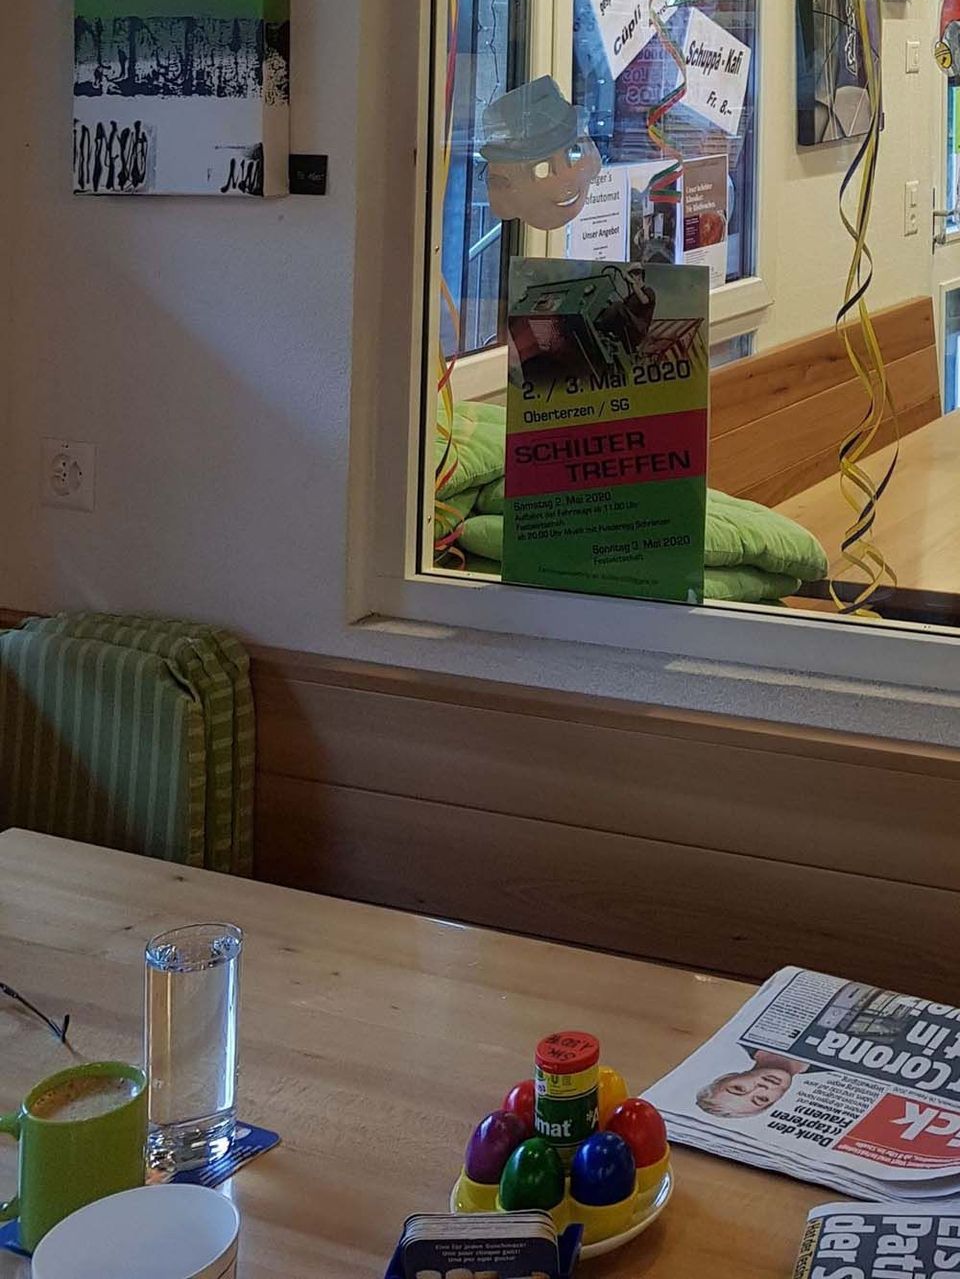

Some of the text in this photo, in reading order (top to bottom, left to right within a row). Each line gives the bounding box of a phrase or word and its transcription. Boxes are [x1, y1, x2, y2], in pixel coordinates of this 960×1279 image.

[613, 5, 642, 56] Cüpli
[725, 45, 744, 76] Kafi
[585, 190, 620, 206] ofautomat
[582, 226, 620, 241] Unser Angebot
[522, 381, 541, 401] 2.
[566, 376, 584, 395] 3.
[590, 372, 627, 392] Mai
[632, 359, 691, 386] 2020
[523, 406, 595, 424] Oberterzen
[610, 398, 630, 413] SG
[515, 432, 646, 464] SCHILTER
[564, 450, 692, 483] TREFFEN
[905, 1020, 952, 1057] in
[804, 1030, 952, 1092] Corona-
[537, 1115, 573, 1138] mat
[770, 1110, 842, 1136] «tapferen
[794, 1105, 853, 1129] Frauen»
[767, 1120, 834, 1148] Dank den
[817, 1215, 876, 1263] der
[870, 1216, 934, 1279] Pati
